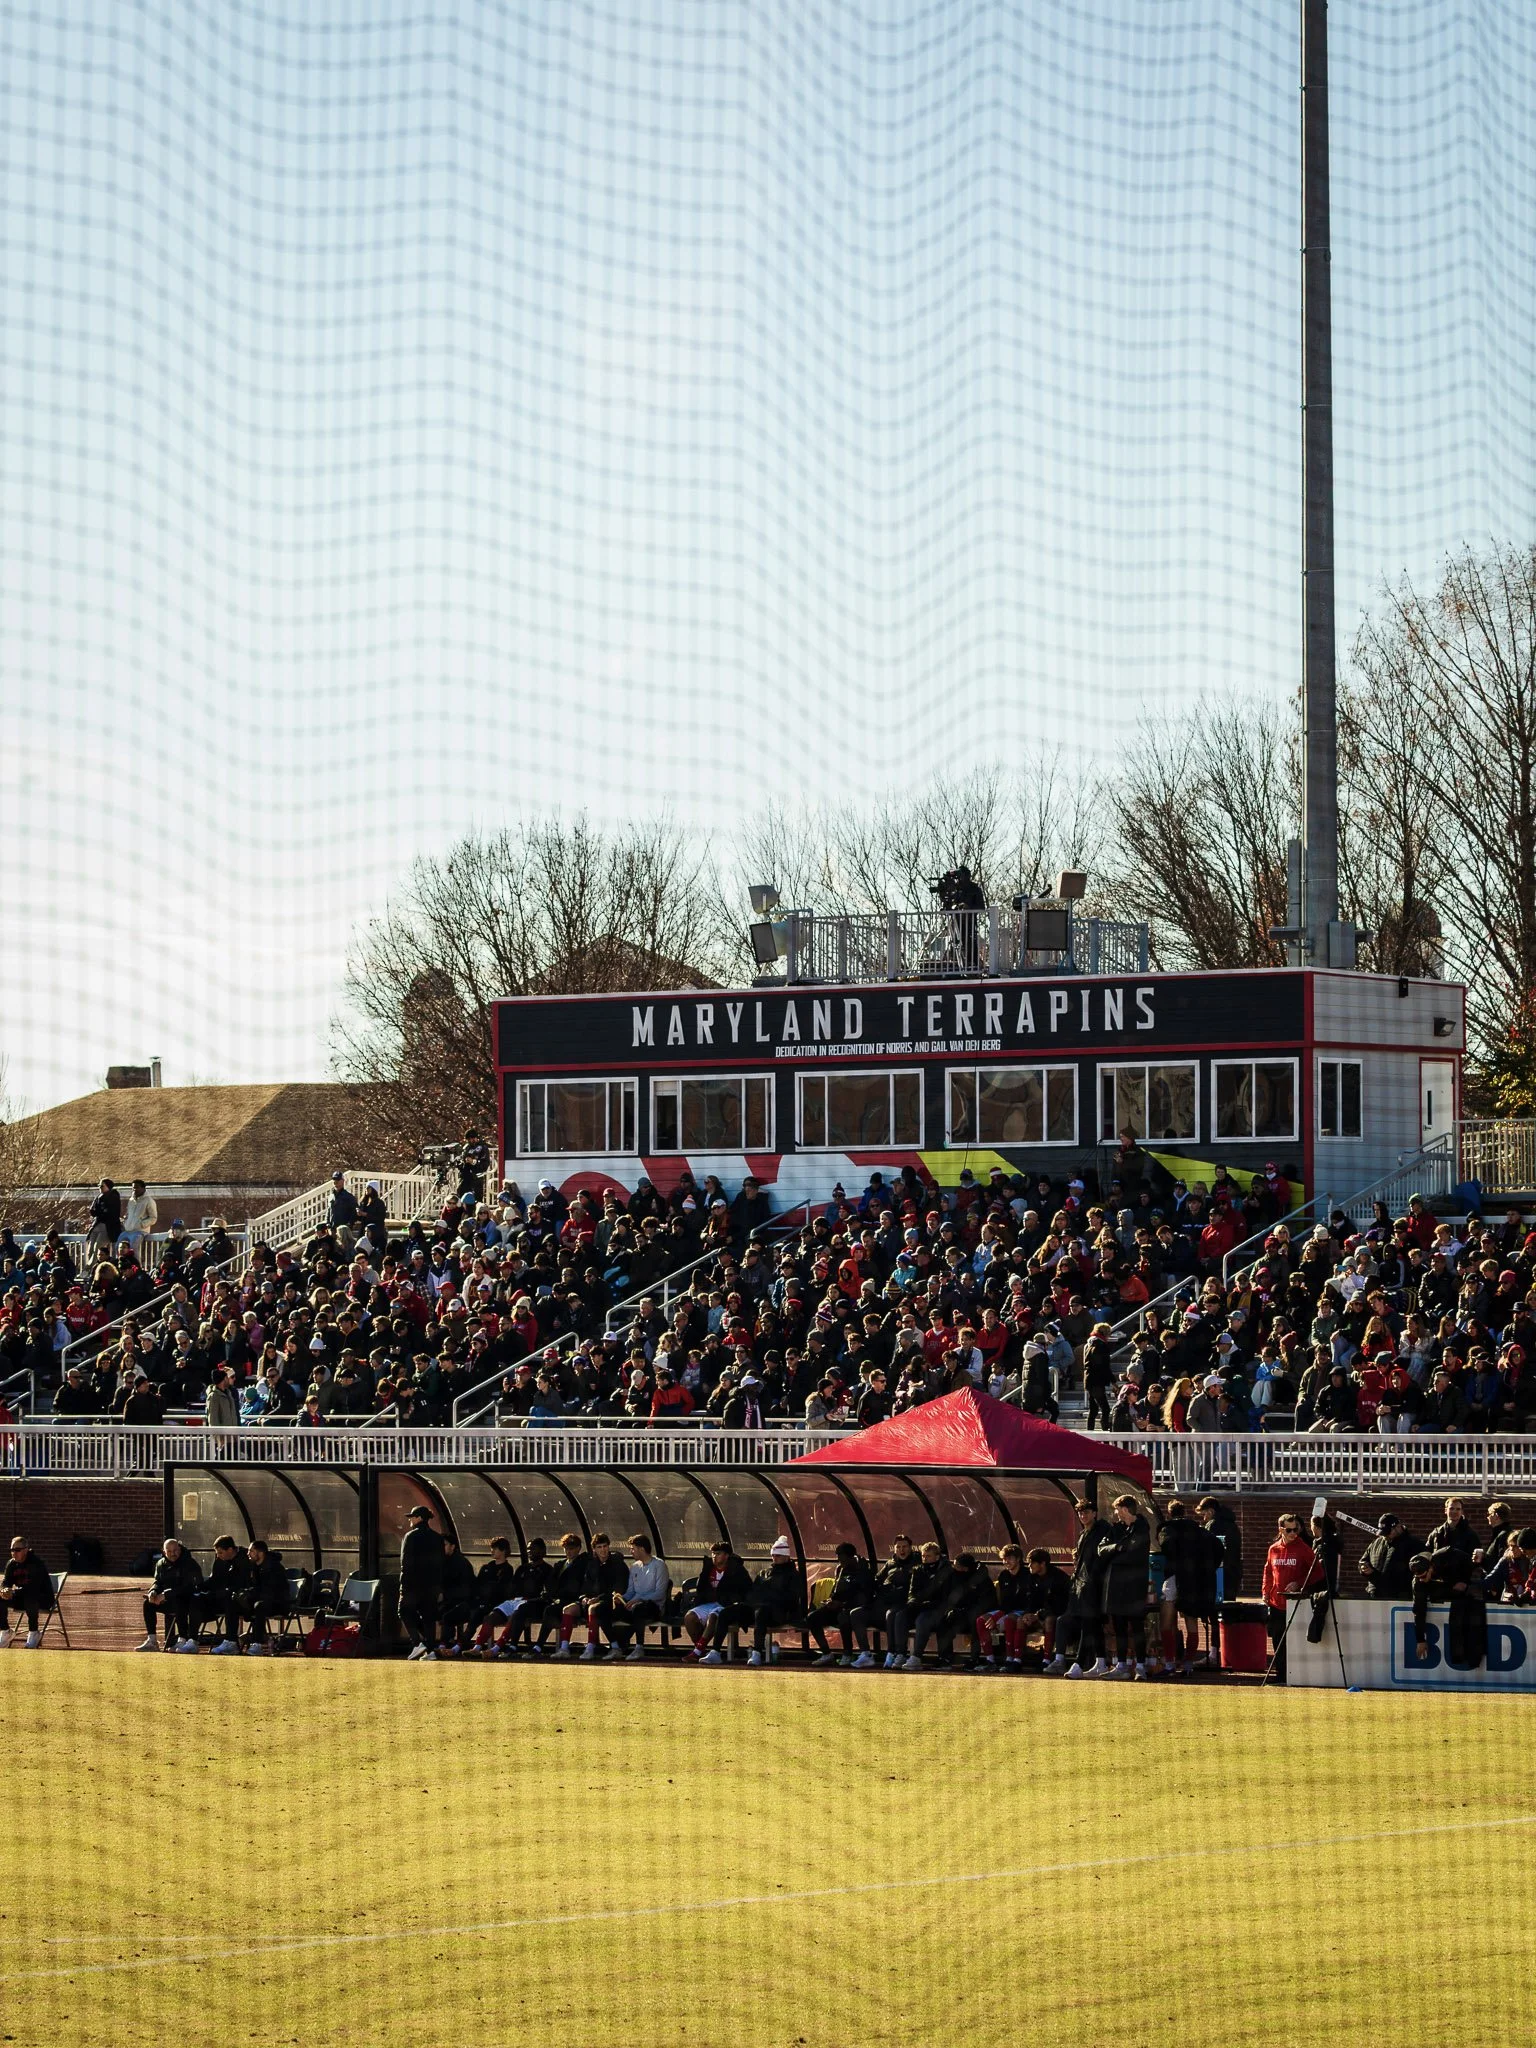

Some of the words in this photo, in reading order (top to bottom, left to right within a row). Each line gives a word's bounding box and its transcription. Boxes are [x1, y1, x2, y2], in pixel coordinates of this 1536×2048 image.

[631, 998, 863, 1047] MARYLAND
[897, 987, 1157, 1038] TERRAPINS
[775, 1045, 817, 1058] DEDICATION
[819, 1044, 827, 1056] IN
[828, 1043, 875, 1056] RECOGNITION
[876, 1042, 886, 1054] OF
[886, 1041, 913, 1053] NORRIS
[914, 1041, 930, 1053] AND
[931, 1041, 948, 1052] GAIL
[949, 1040, 964, 1052] VAN
[965, 1040, 980, 1051] DEN
[981, 1039, 1001, 1051] BERG
[1272, 1558, 1297, 1566] MARYLAND
